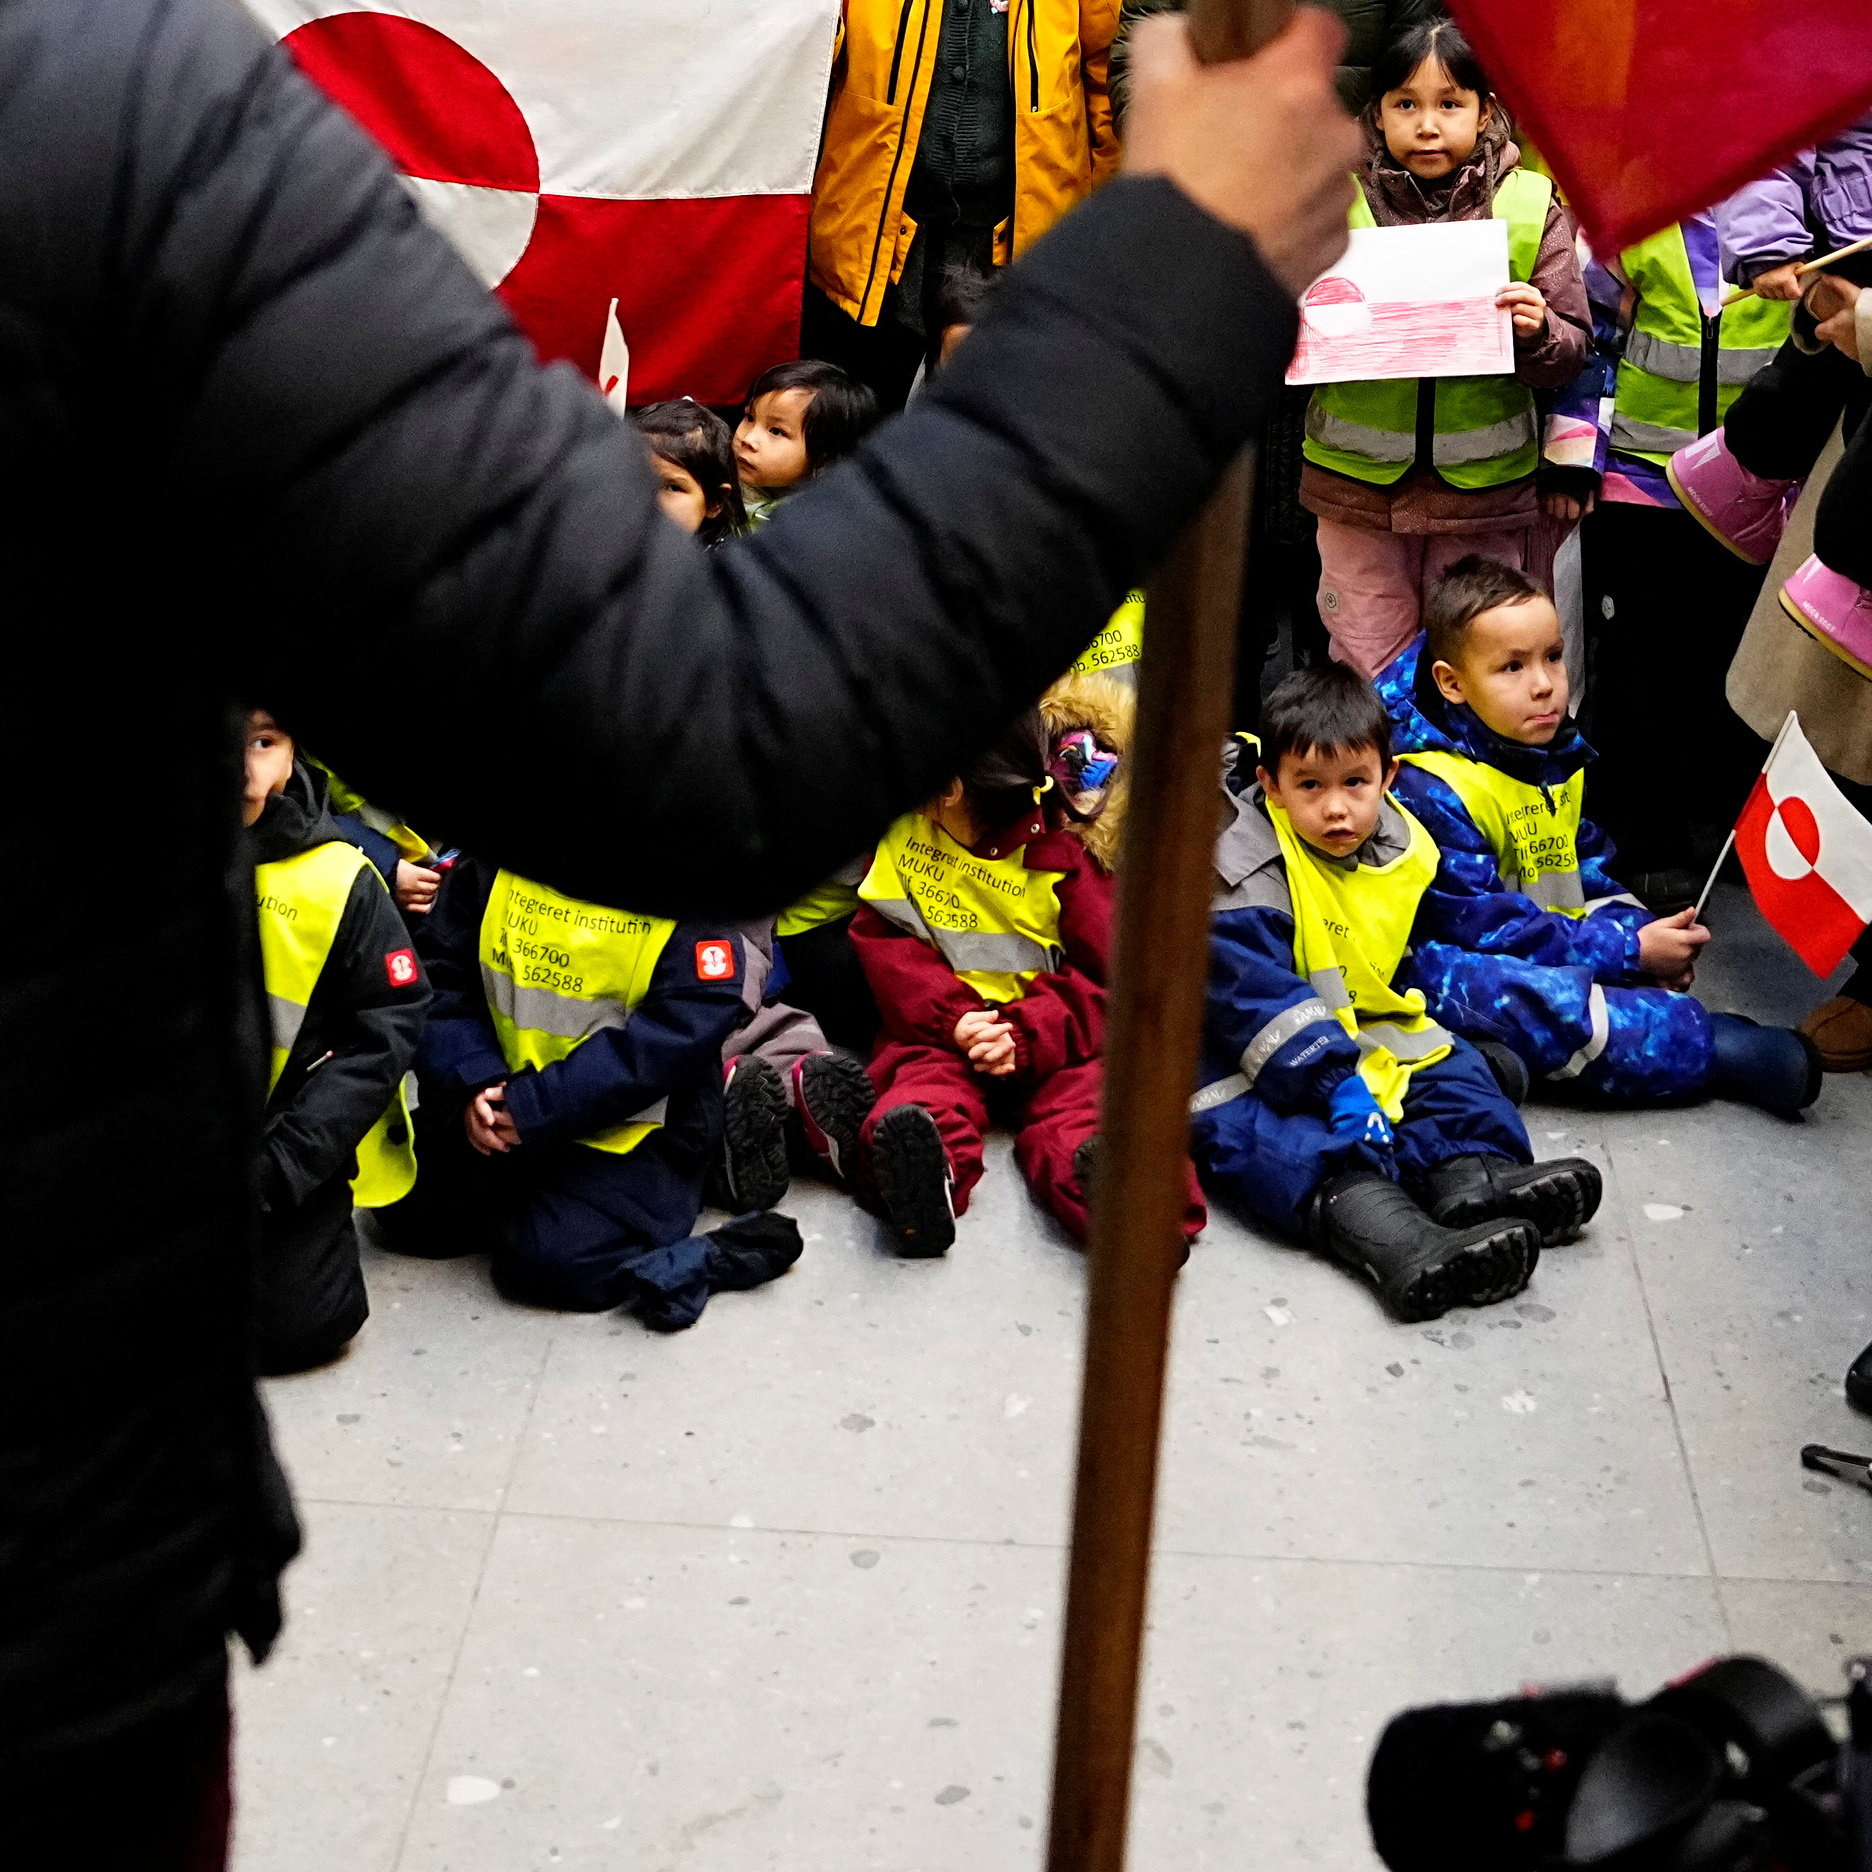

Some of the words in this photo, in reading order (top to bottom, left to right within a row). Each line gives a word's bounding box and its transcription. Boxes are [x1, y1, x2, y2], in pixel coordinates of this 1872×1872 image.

[1091, 643, 1140, 667] 562588
[897, 853, 945, 882] MUKU
[506, 910, 540, 936] UKU
[574, 909, 652, 936] institutin
[925, 905, 979, 929] 562588
[512, 937, 571, 968] 366700
[522, 964, 584, 993] 562588
